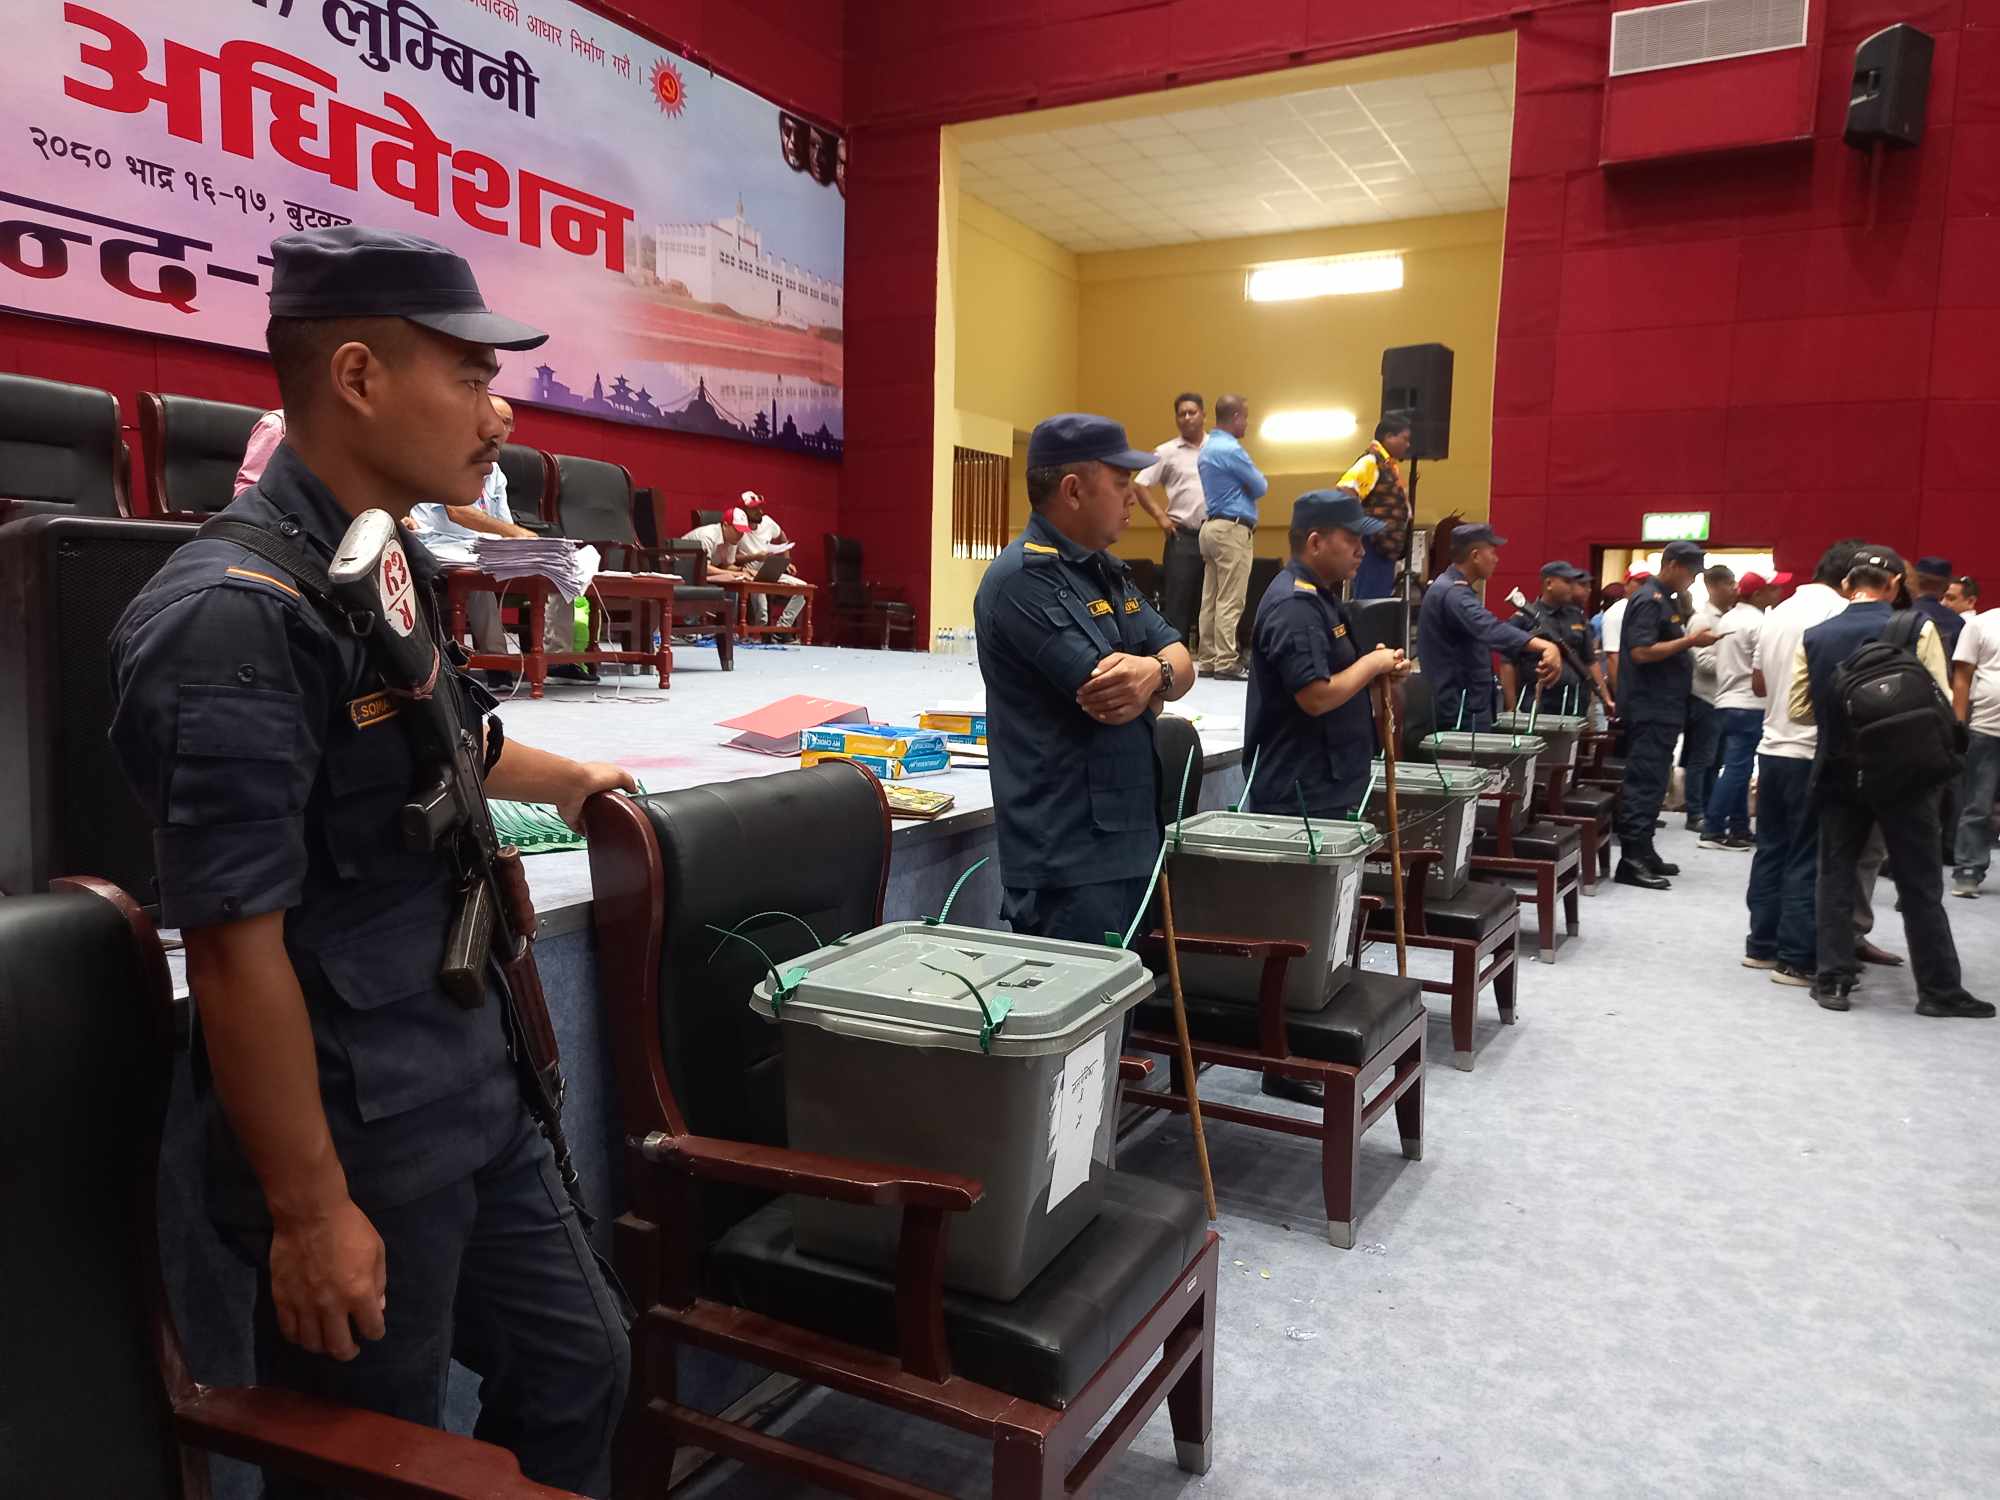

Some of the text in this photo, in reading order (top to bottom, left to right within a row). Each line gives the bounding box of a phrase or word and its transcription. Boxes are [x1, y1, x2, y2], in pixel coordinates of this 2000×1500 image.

[322, 0, 540, 119] लुम्बिनी
[526, 15, 563, 48] आधार
[569, 28, 605, 67] निर्माण
[28, 126, 112, 170] २०८०
[125, 155, 176, 193] भाद्र
[64, 2, 634, 273] अधिवेशन
